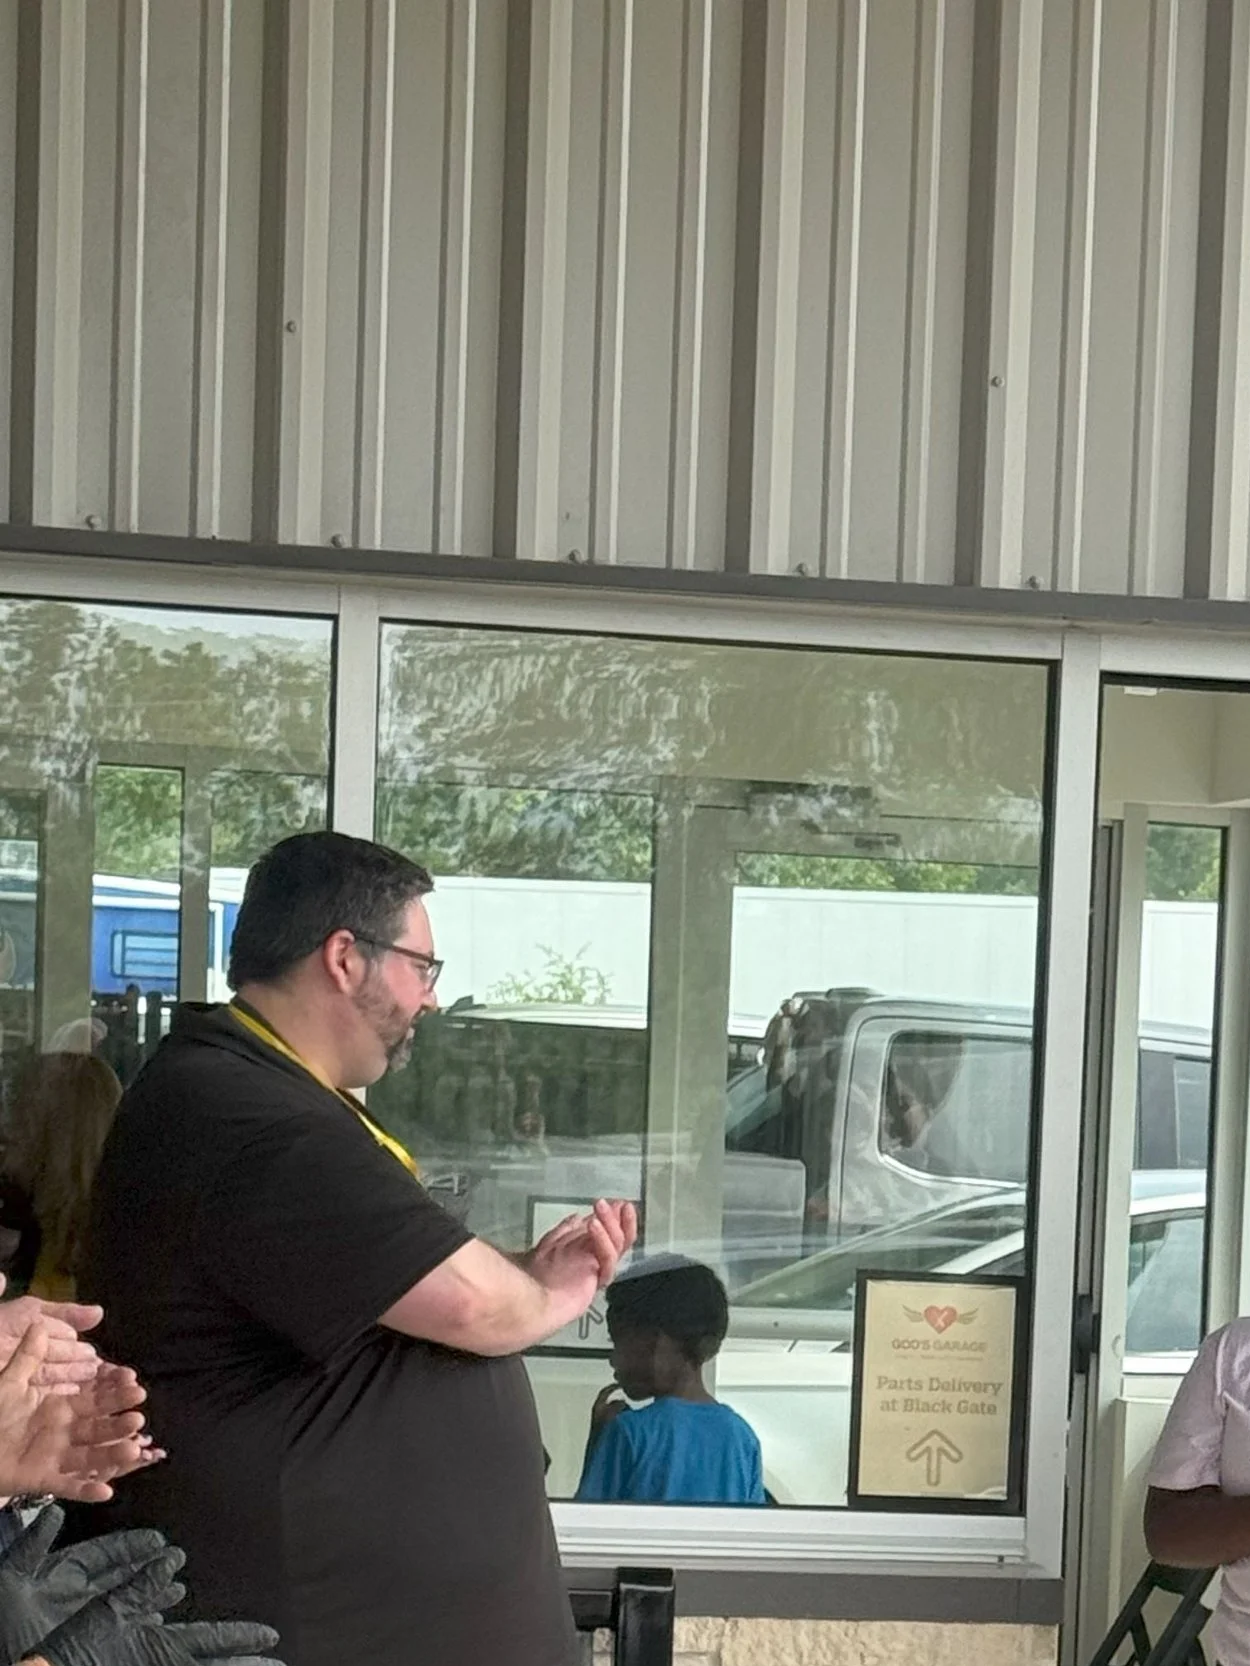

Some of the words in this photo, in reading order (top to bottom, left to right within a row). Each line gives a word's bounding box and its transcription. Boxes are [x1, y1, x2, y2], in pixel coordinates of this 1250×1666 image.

[933, 1339, 988, 1353] GARAGE
[876, 1375, 924, 1392] Parts
[928, 1377, 1004, 1396] Delivery
[879, 1399, 899, 1413] at
[902, 1398, 953, 1414] Black
[955, 1400, 998, 1415] Gate
